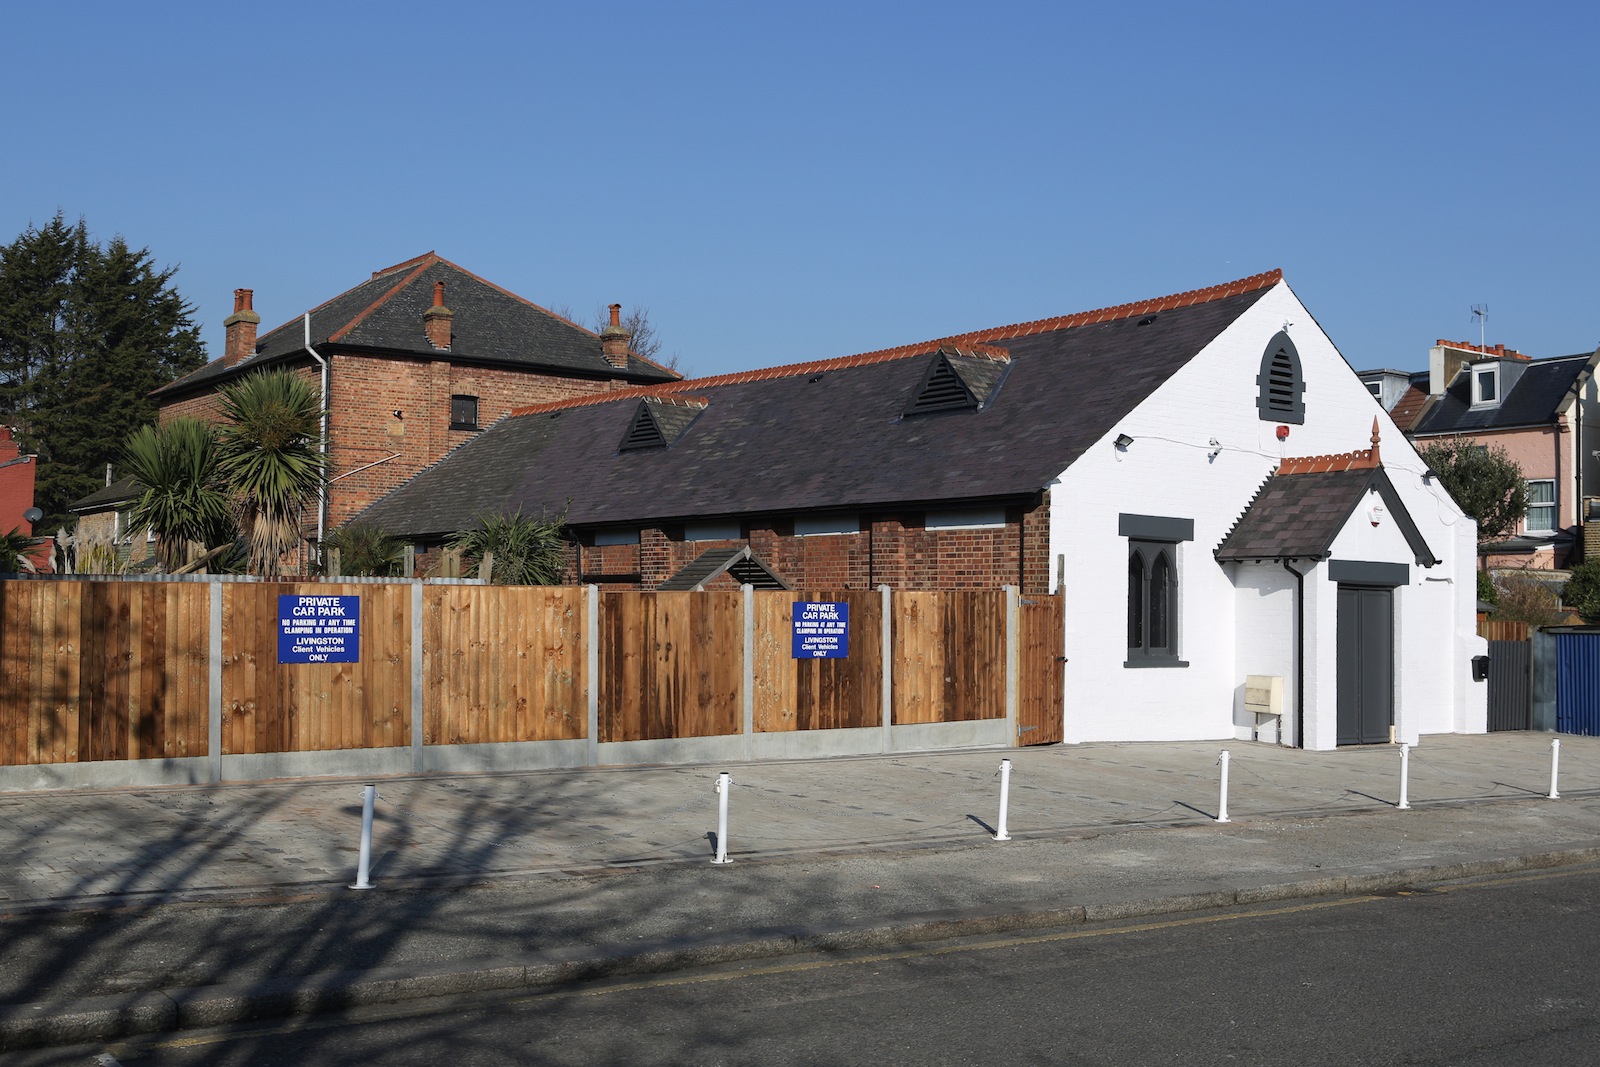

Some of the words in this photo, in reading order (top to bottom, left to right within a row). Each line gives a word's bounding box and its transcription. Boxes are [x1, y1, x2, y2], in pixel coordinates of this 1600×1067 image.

[299, 597, 340, 606] PRIVATE
[293, 607, 315, 616] CAR
[318, 607, 345, 616] PARK
